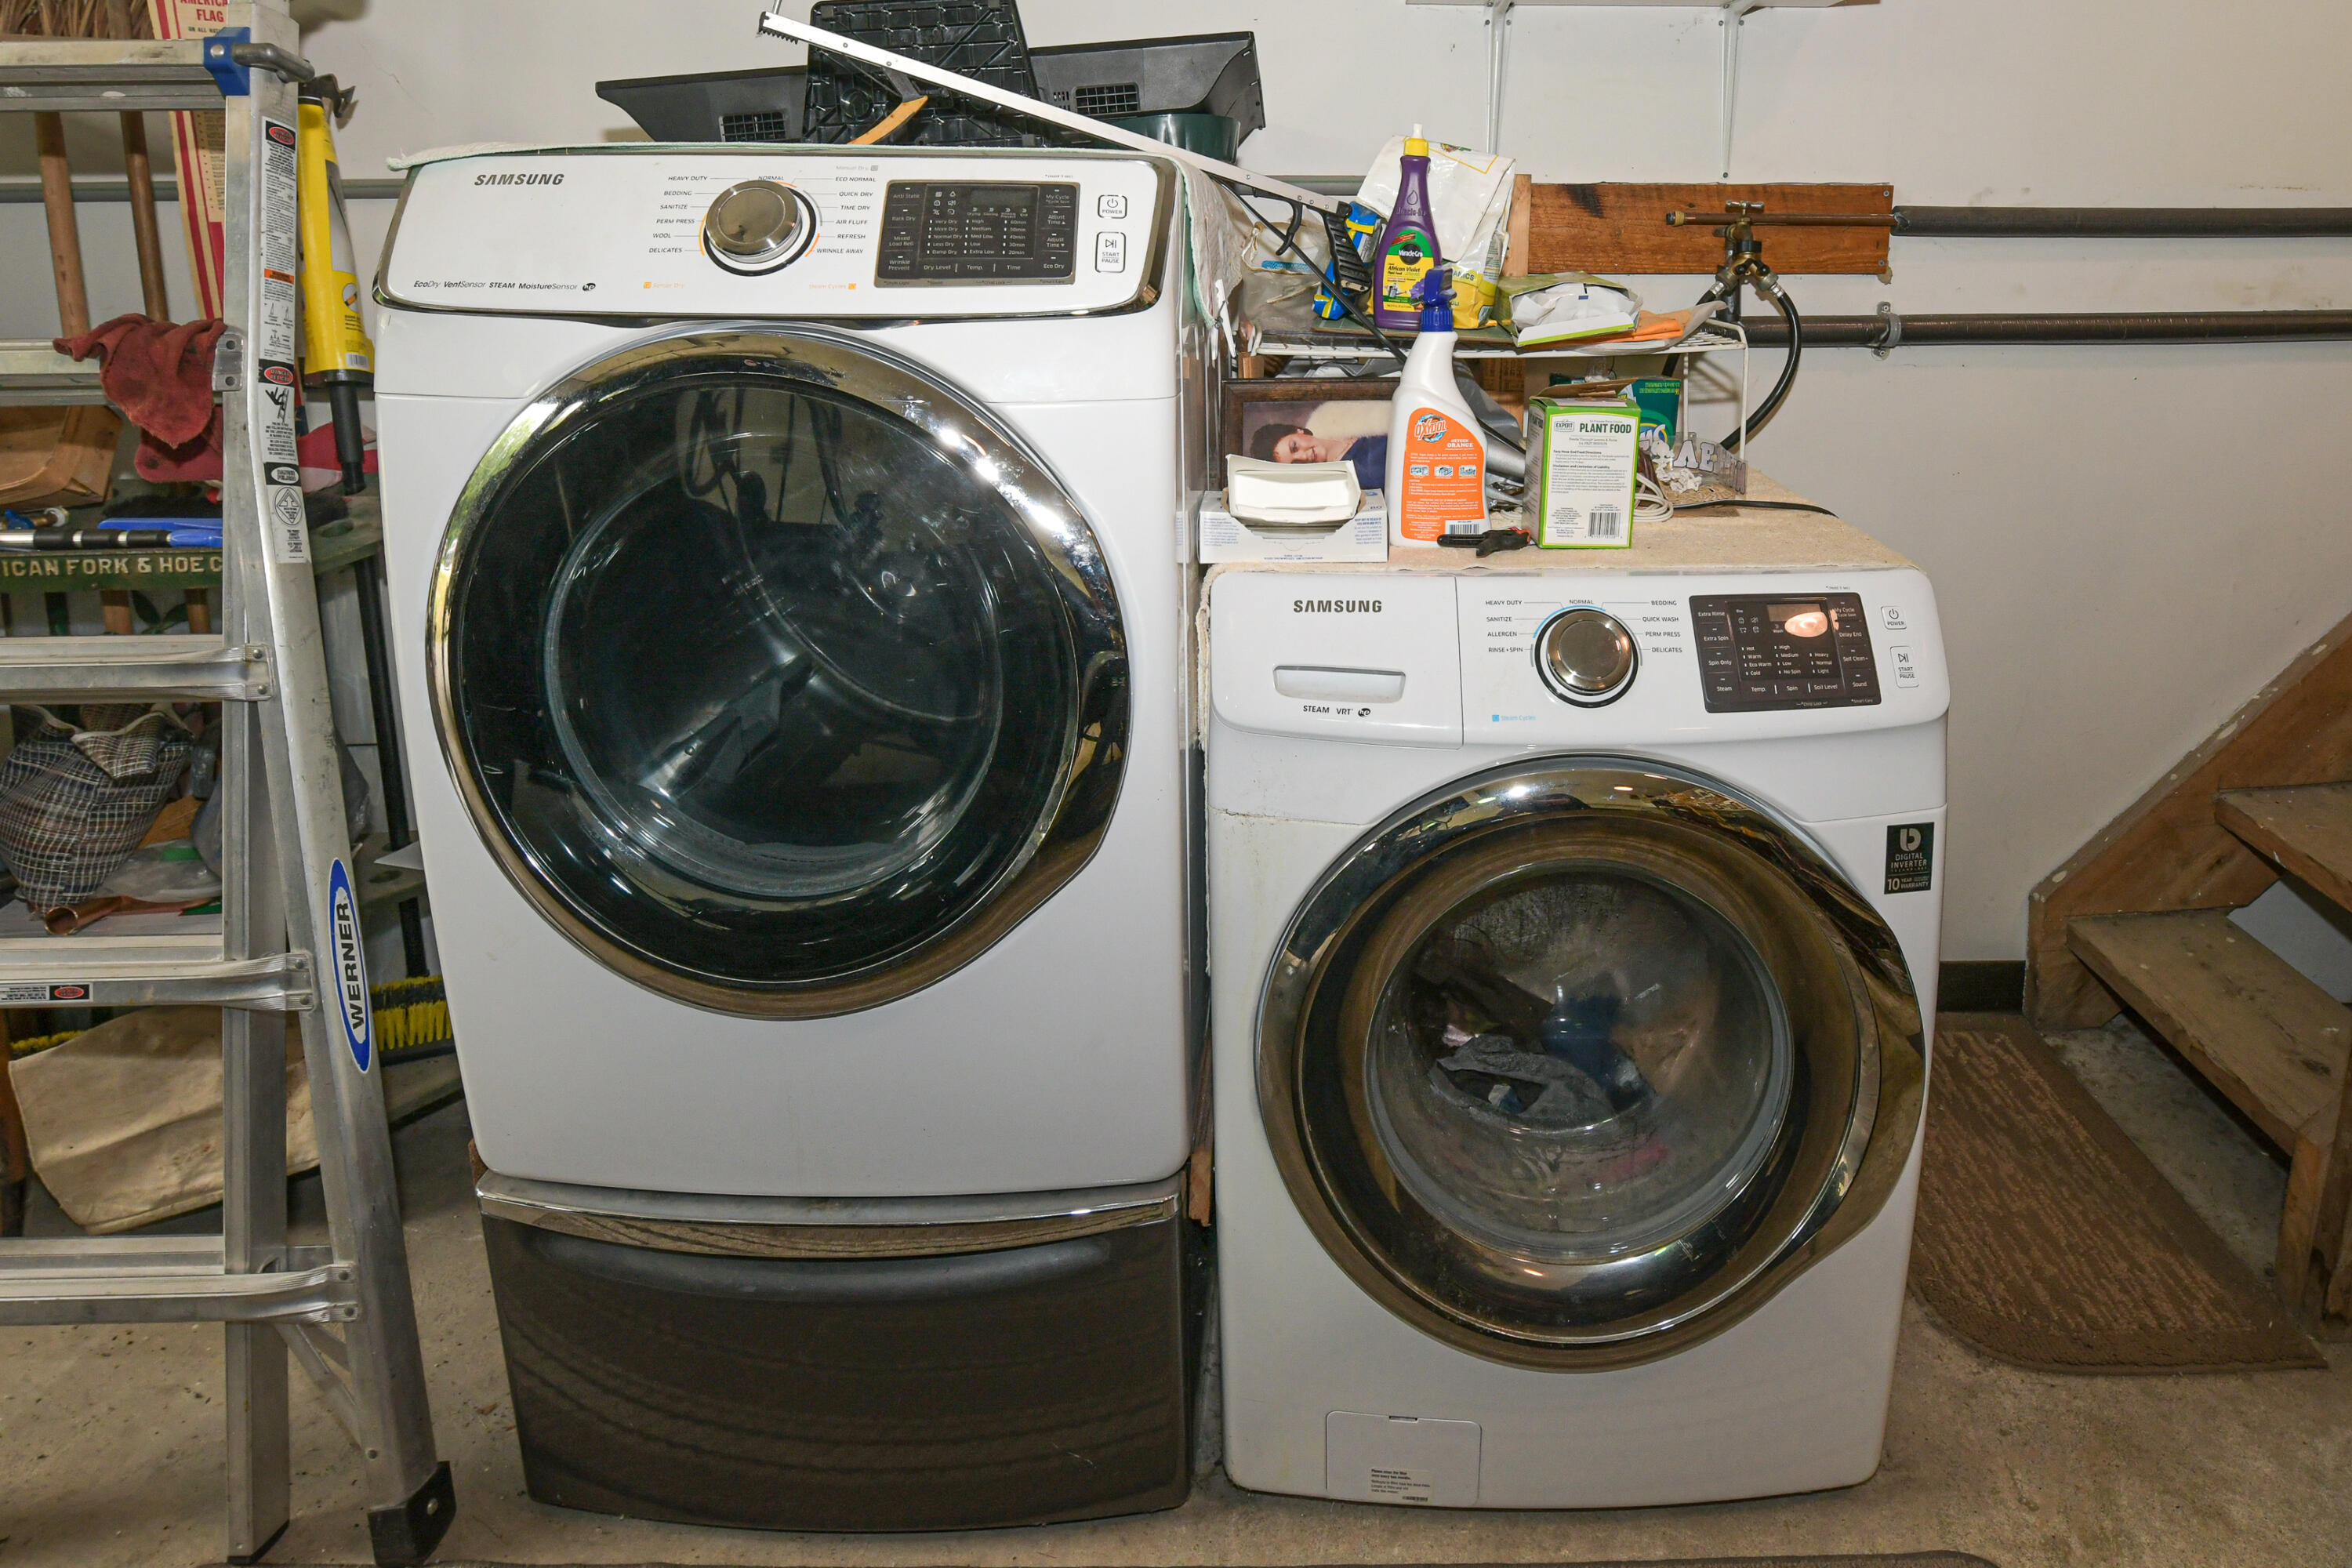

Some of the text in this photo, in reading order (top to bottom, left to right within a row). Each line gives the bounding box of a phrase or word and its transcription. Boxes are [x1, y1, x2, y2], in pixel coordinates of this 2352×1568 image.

[197, 9, 224, 22] FLAG
[474, 173, 564, 186] SAMSUNG
[1580, 423, 1632, 433] PLANT FOOD
[67, 558, 129, 576] FORK
[137, 557, 152, 574] &
[159, 557, 205, 573] HOE
[1294, 600, 1383, 613] SAMSUNG
[1896, 852, 1924, 861] DIGITAL
[1891, 859, 1927, 869] INVERTER
[1887, 878, 1900, 891] 10
[336, 902, 365, 1030] WERNER
